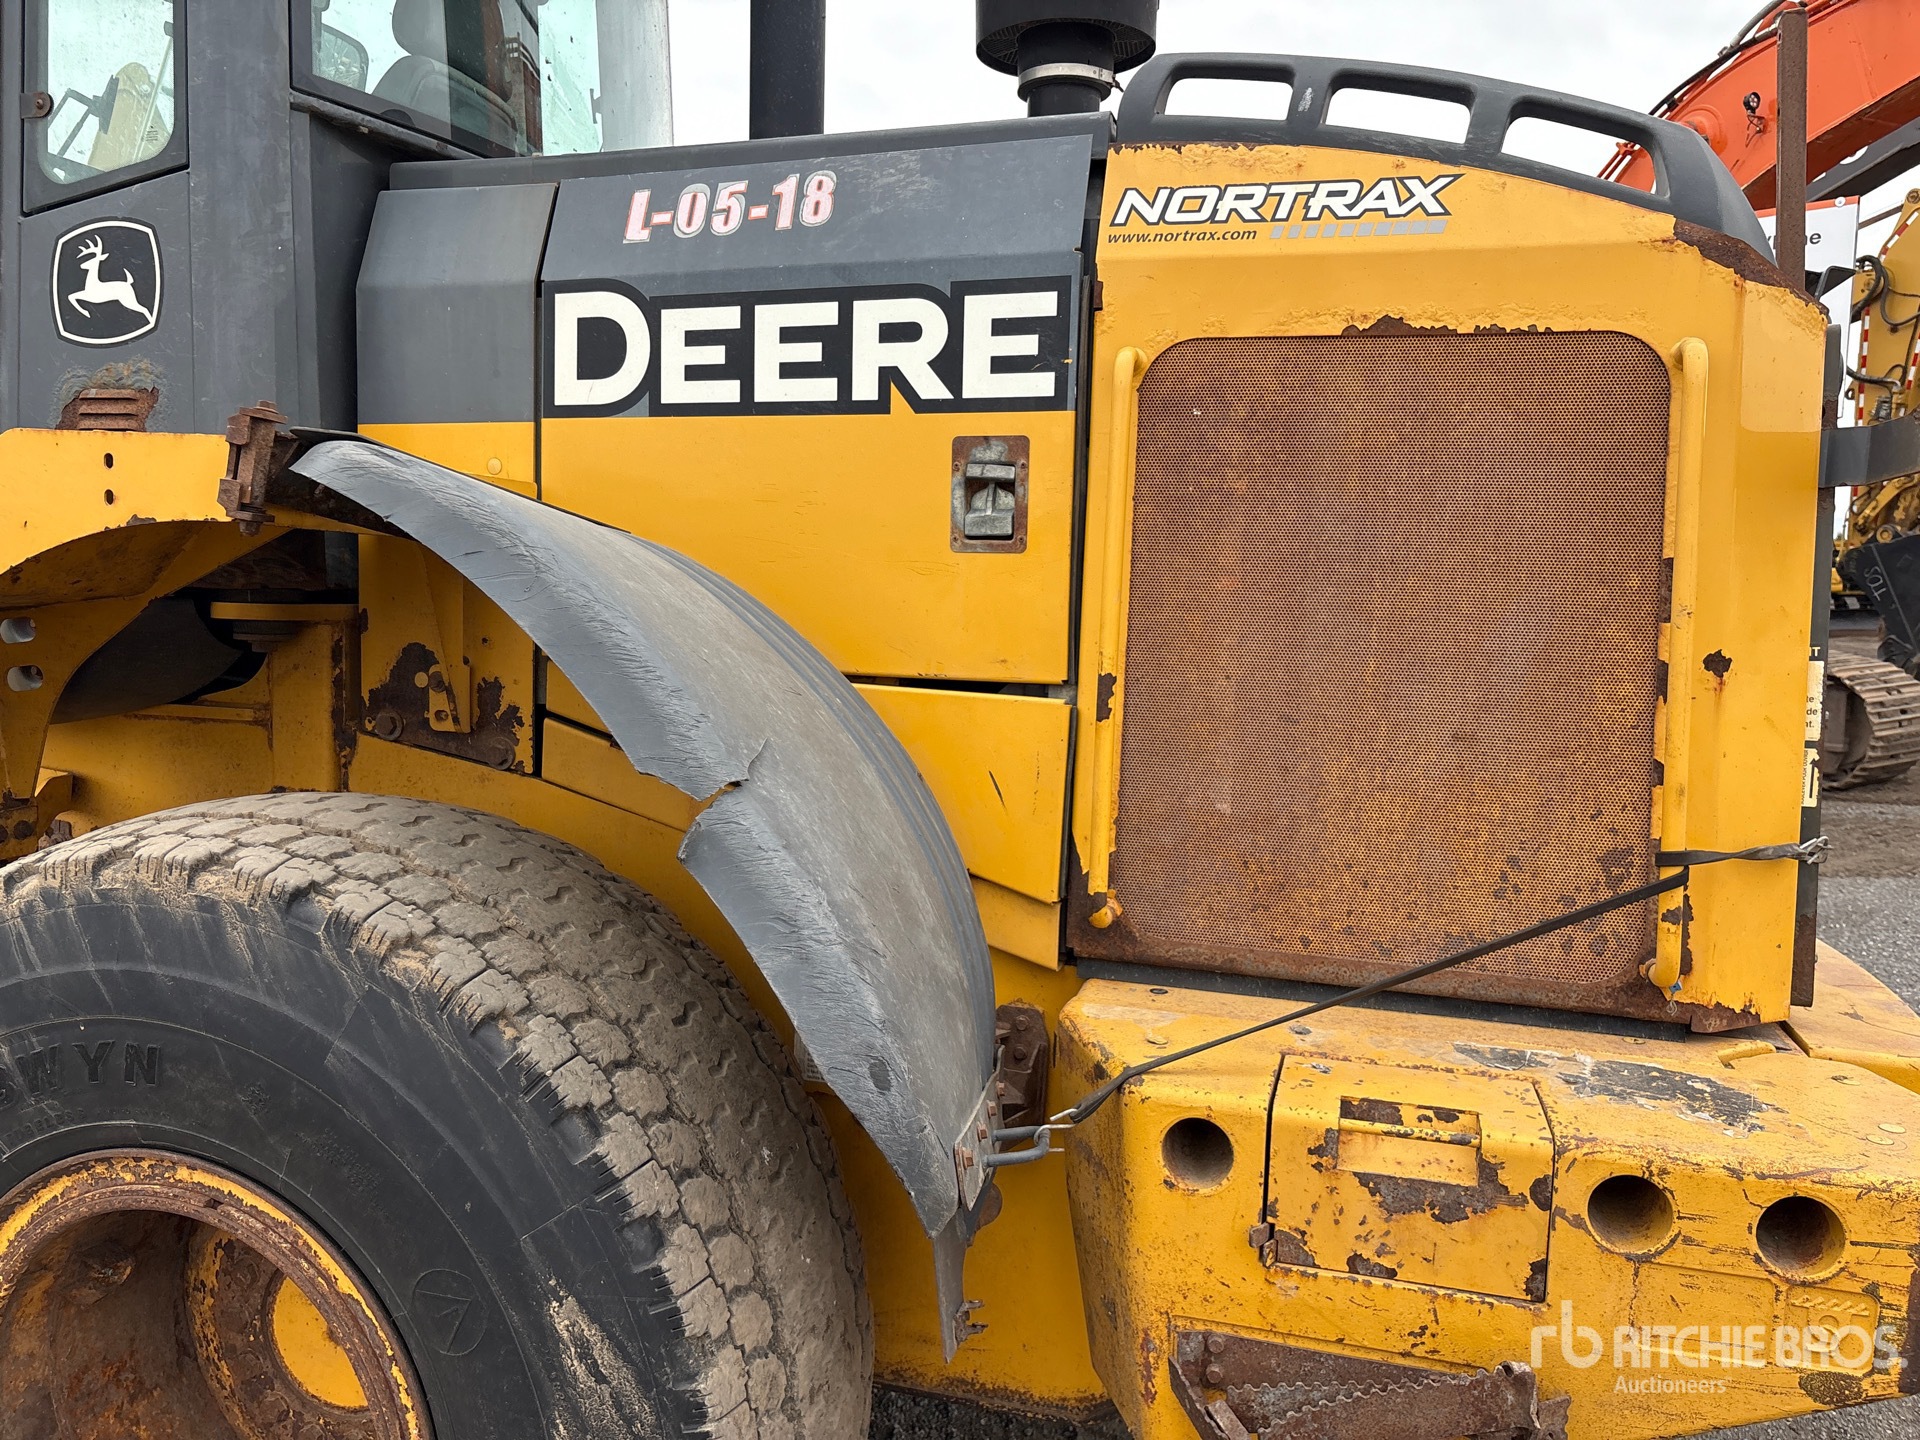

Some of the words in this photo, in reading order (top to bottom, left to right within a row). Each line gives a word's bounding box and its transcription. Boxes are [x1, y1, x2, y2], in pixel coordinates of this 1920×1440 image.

[623, 170, 837, 243] L-05-18
[1110, 173, 1466, 227] NORTRAX
[1107, 228, 1258, 244] www.nortrax.com
[553, 290, 1059, 406] DEERE
